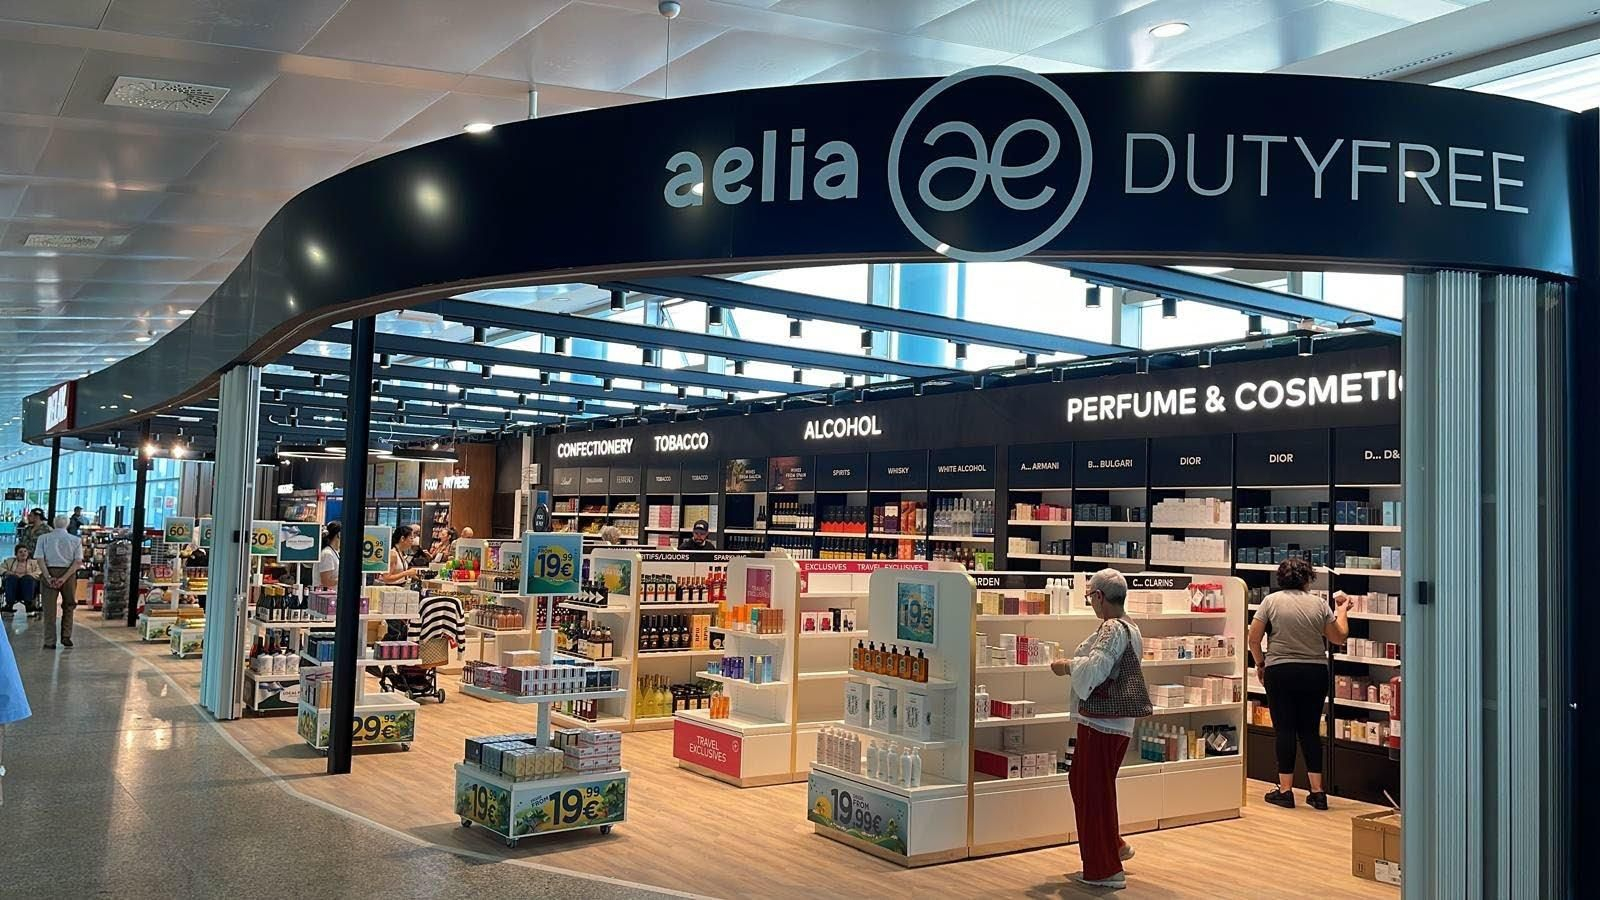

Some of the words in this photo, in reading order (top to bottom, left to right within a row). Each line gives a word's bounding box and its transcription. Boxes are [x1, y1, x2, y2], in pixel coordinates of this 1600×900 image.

[663, 128, 859, 208] aelia
[1067, 388, 1197, 422] PERFUME
[1204, 385, 1226, 413] &
[1235, 369, 1402, 411] COSMETI
[804, 415, 882, 440] ALCOHOL
[654, 432, 709, 452] TOBACCO
[557, 438, 634, 458] CONFECTIONERY
[1100, 459, 1133, 468] BULGARI
[1180, 456, 1202, 466] DIOR
[1269, 453, 1294, 463] DIOR
[887, 467, 909, 475] WHISKY
[938, 465, 957, 473] WHITE
[957, 464, 987, 472] ALCOHOL
[1032, 462, 1060, 470] ARMANI
[804, 563, 848, 571] EXCLUSIVES
[1144, 578, 1175, 587] CLARINS
[696, 735, 720, 751] TRAVEL
[688, 742, 728, 763] EXCLUSIVES
[531, 795, 549, 808] FROM
[852, 799, 870, 810] FROM
